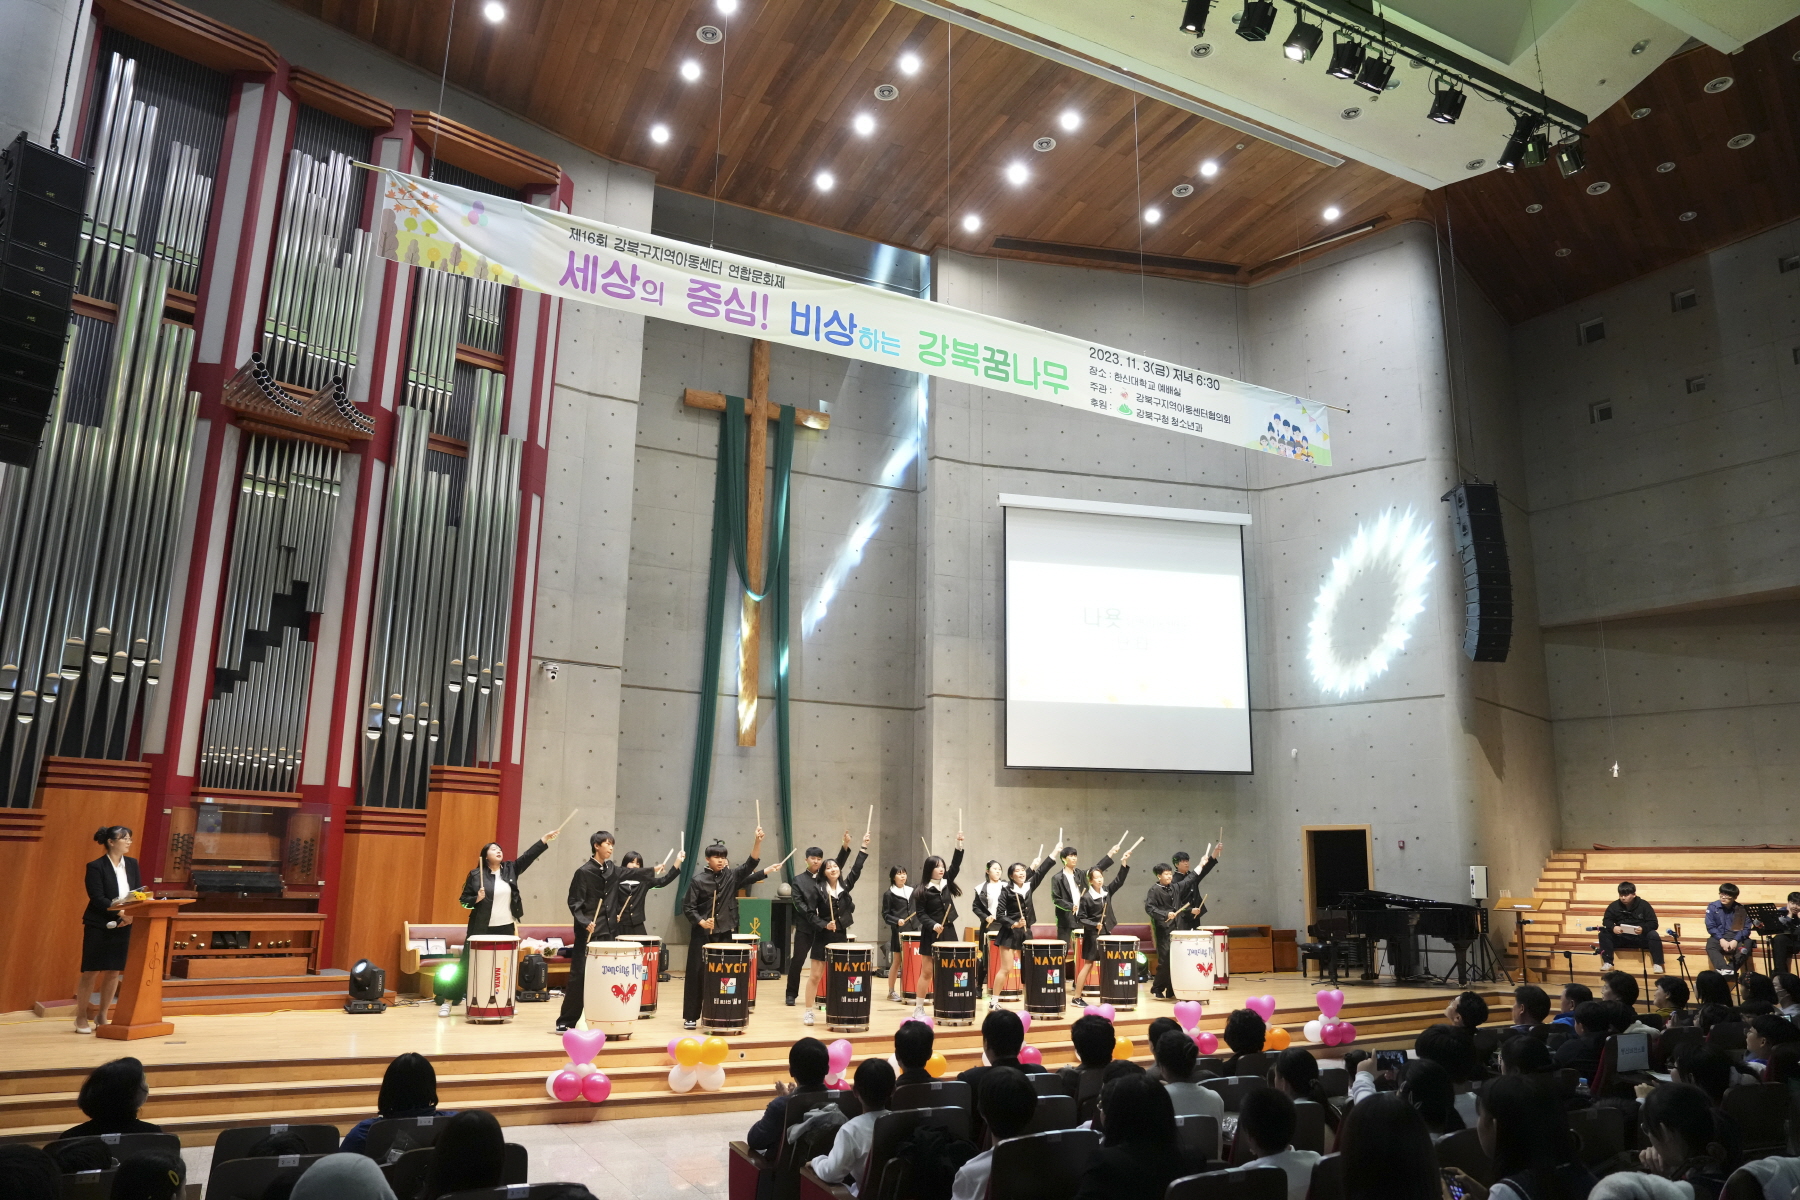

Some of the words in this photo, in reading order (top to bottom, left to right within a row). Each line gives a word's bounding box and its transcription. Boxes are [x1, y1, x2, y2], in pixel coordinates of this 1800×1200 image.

[568, 227, 608, 249] 제16회
[613, 237, 723, 276] 강북구지역아동센터
[728, 264, 786, 290] 연합문화제
[558, 250, 665, 307] 세상의
[686, 277, 770, 331] 중심!
[790, 300, 901, 357] 비상하는
[918, 330, 1070, 395] 강북꿈나무
[1114, 371, 1156, 391] 한신대학교
[1157, 383, 1182, 397] 예배실
[1173, 368, 1194, 385] 저녁
[1196, 374, 1221, 391] 6:30
[1136, 392, 1231, 425] 강북구지역아동센터협의회
[1136, 408, 1169, 425] 강북구청
[1171, 416, 1203, 433] 청소년과
[708, 962, 748, 974] NAYOT
[834, 961, 871, 972] NAYOT
[1033, 955, 1064, 966] NAYO
